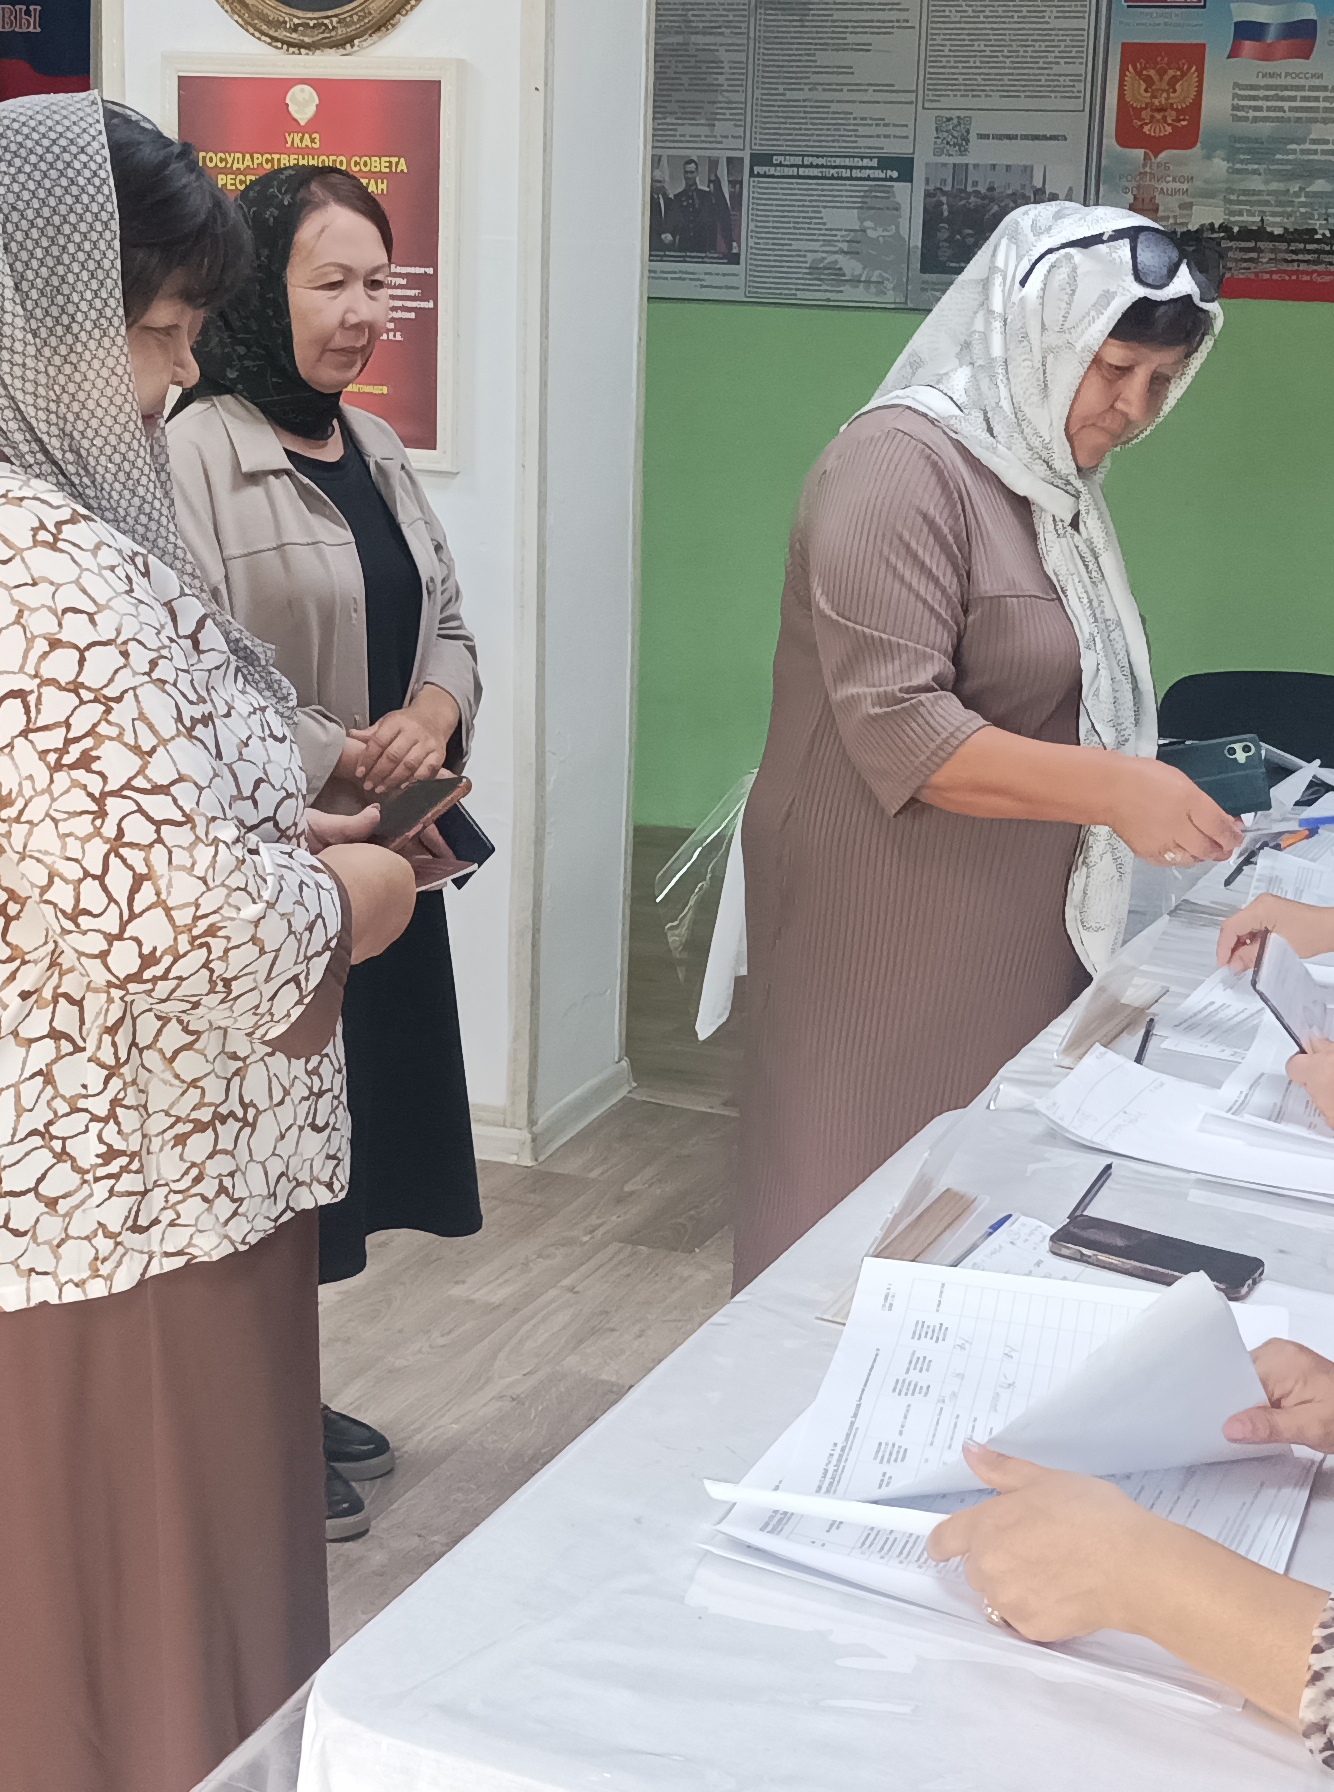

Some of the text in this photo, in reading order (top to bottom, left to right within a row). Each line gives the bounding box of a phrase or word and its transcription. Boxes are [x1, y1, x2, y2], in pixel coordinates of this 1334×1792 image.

[1256, 71, 1324, 81] ГИМН РОССИИ
[284, 132, 321, 149] УКАЗ
[198, 151, 408, 173] ГОСУДАРСТВЕННОГО СОВЕТА
